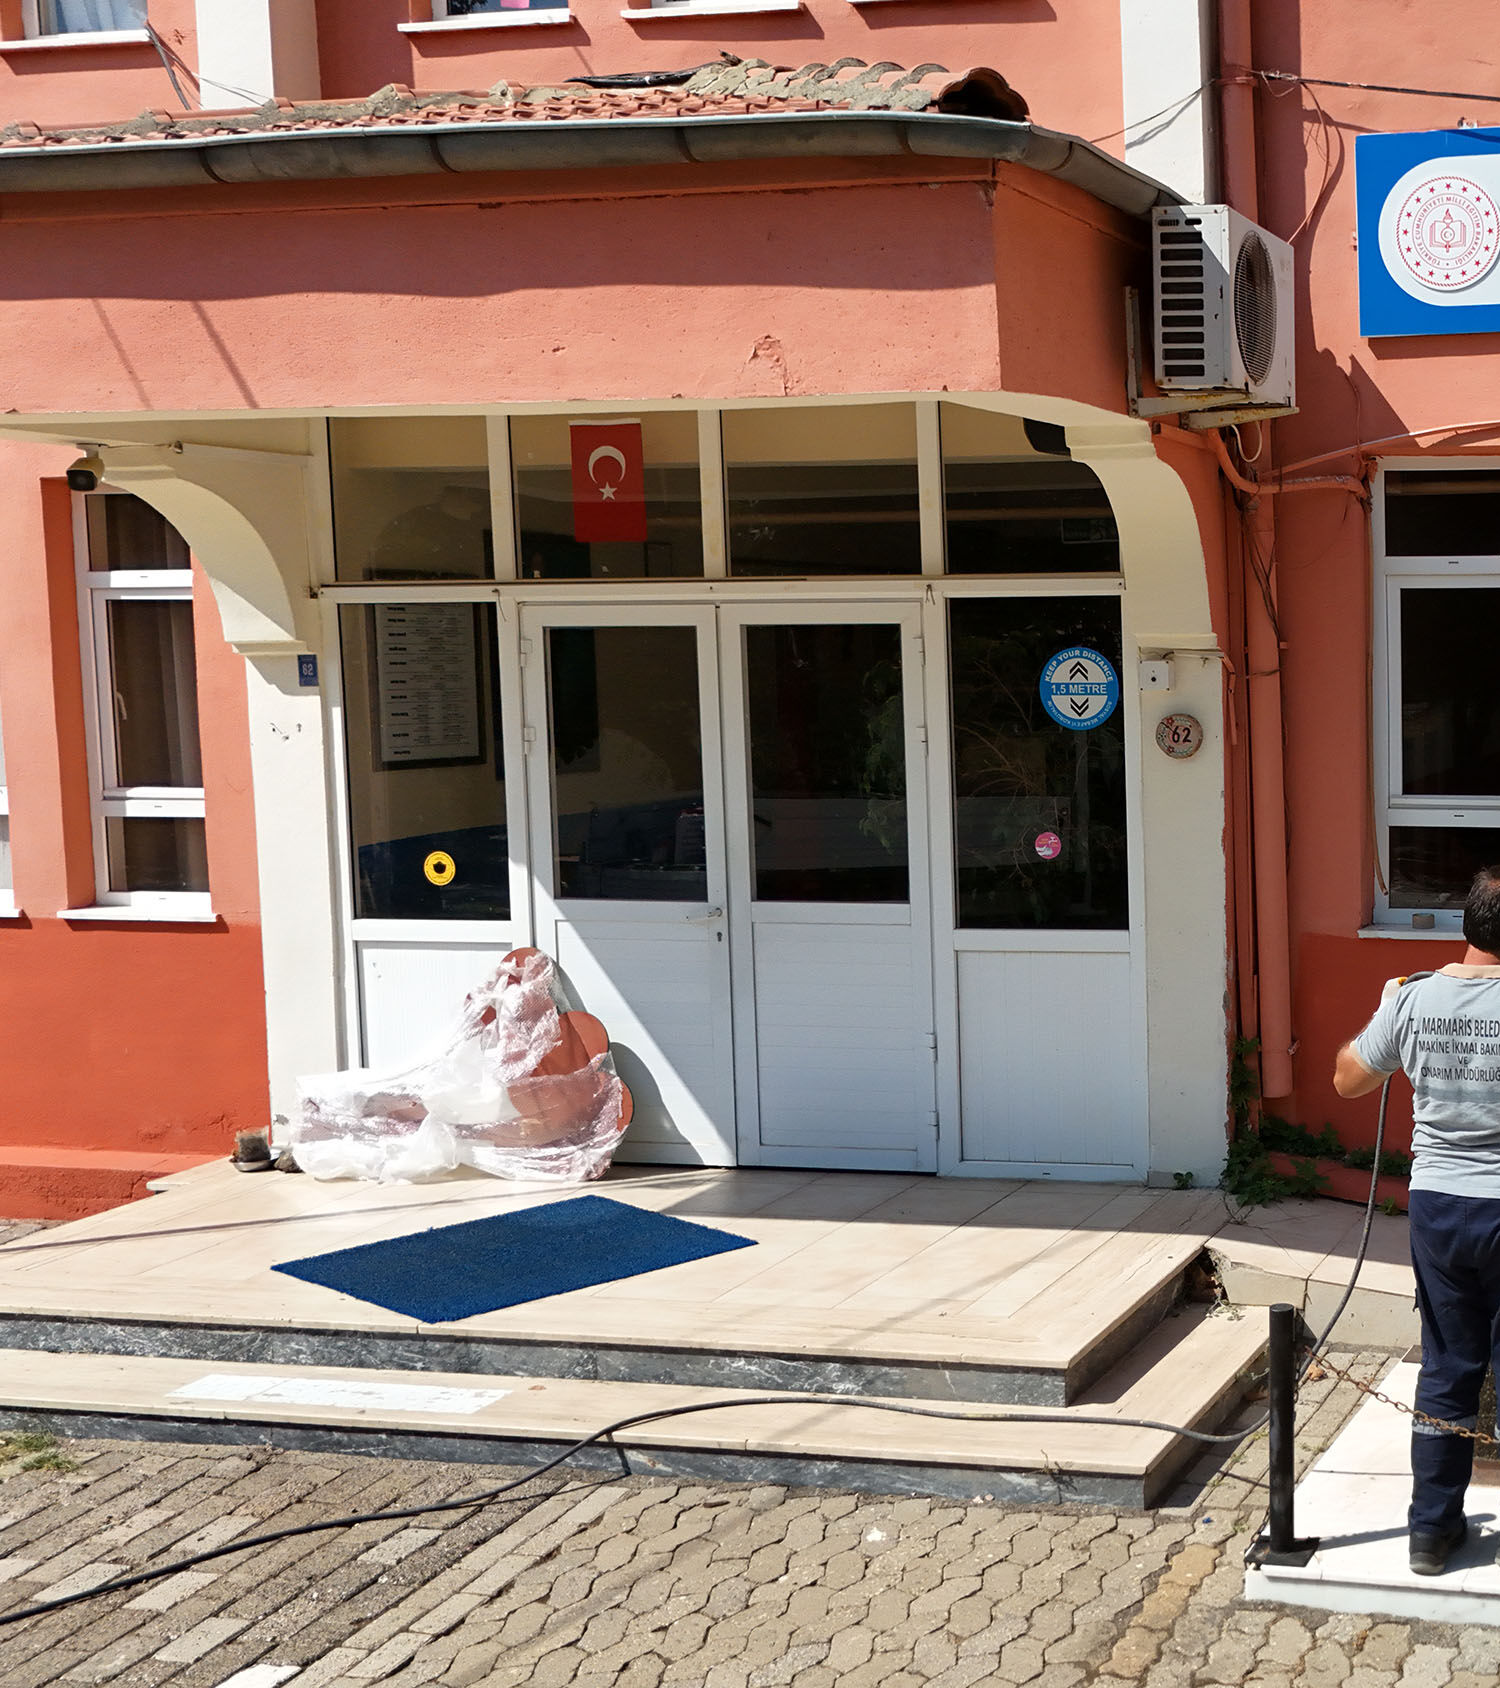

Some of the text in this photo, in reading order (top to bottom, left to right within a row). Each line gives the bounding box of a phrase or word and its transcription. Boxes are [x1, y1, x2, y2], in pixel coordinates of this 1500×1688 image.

[1044, 650, 1114, 682] KEEP YOUR DISTANCE
[1051, 684, 1107, 695] 1,5 METRE
[1172, 725, 1192, 743] 62
[1422, 1015, 1472, 1036] MARMARİS
[1418, 1038, 1450, 1054] MAKİNE
[1452, 1039, 1479, 1055] İKMAL
[1457, 1056, 1468, 1065] VE
[1421, 1066, 1453, 1080] ONARIM
